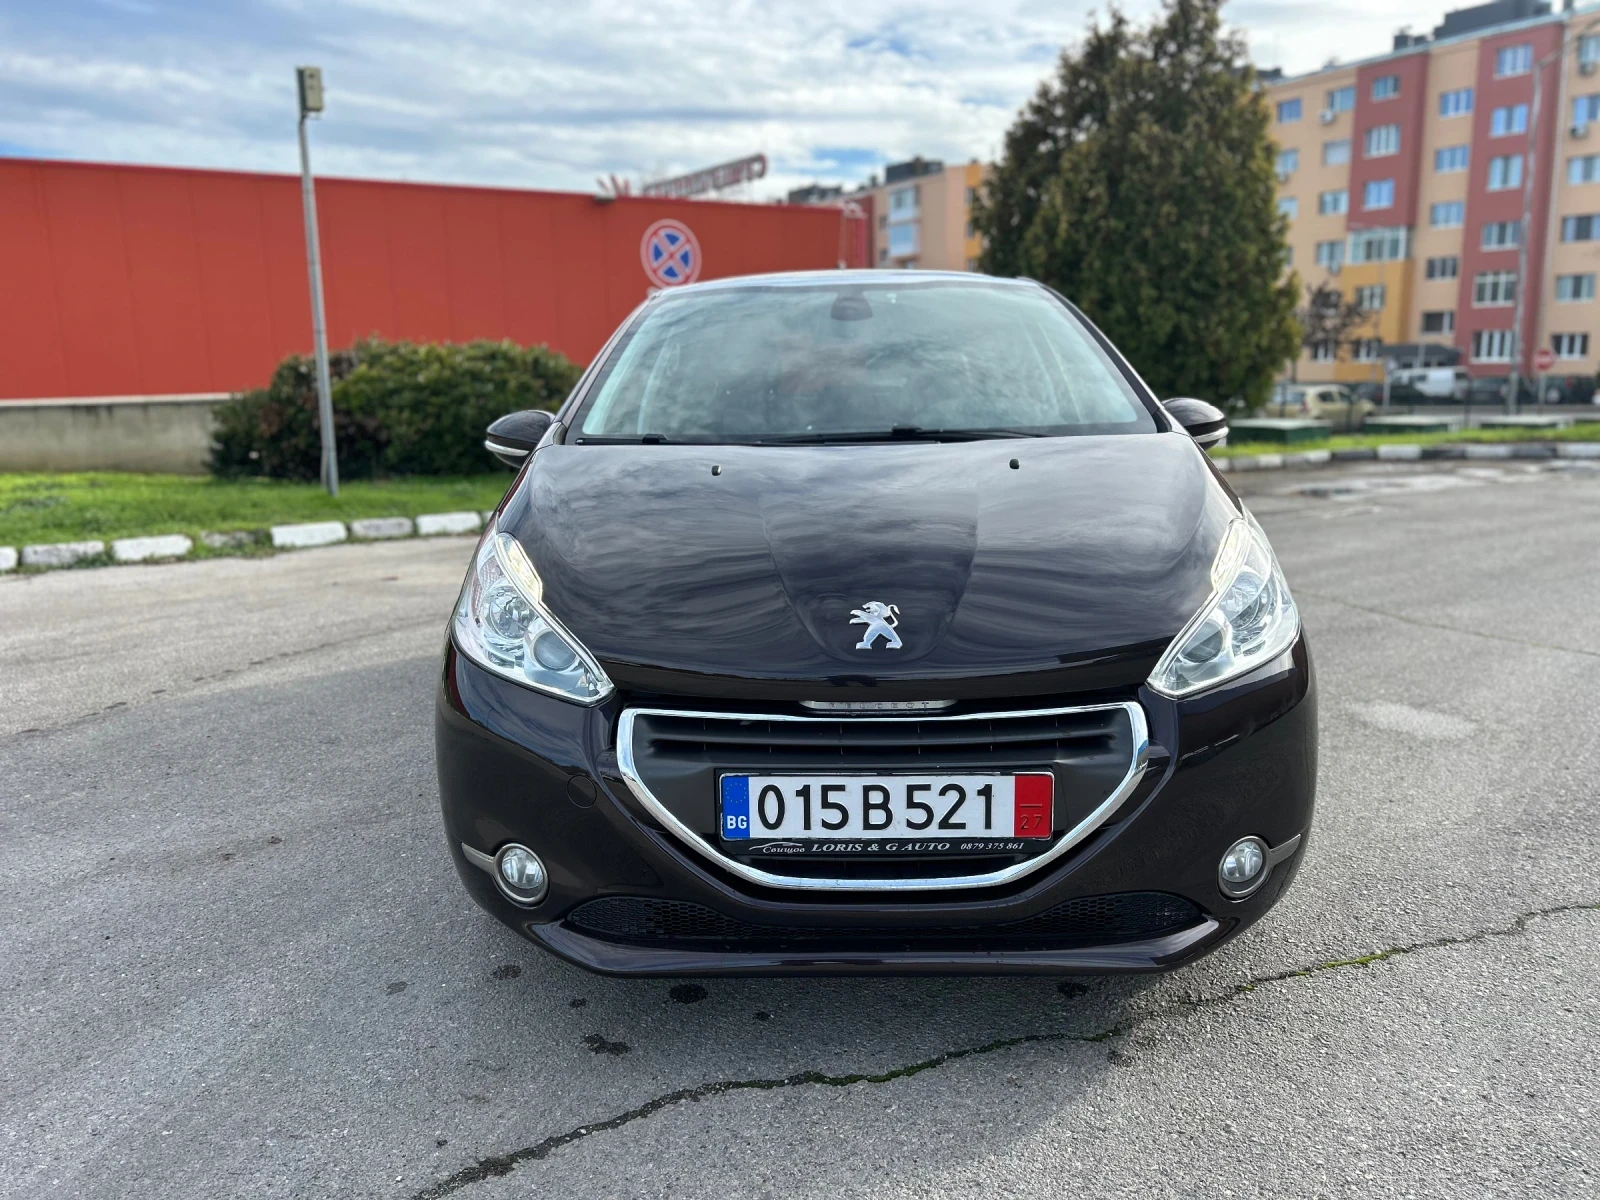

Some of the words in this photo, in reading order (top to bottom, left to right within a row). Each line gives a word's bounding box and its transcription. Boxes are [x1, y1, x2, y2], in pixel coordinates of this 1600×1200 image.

[726, 815, 748, 830] BG
[1020, 814, 1042, 830] 27
[811, 843, 863, 852] LORIS
[867, 843, 880, 851] &
[885, 842, 899, 851] G
[901, 842, 950, 851] AUTO
[960, 842, 985, 850] 0879
[985, 842, 1004, 850] 375
[1006, 842, 1025, 850] 861
